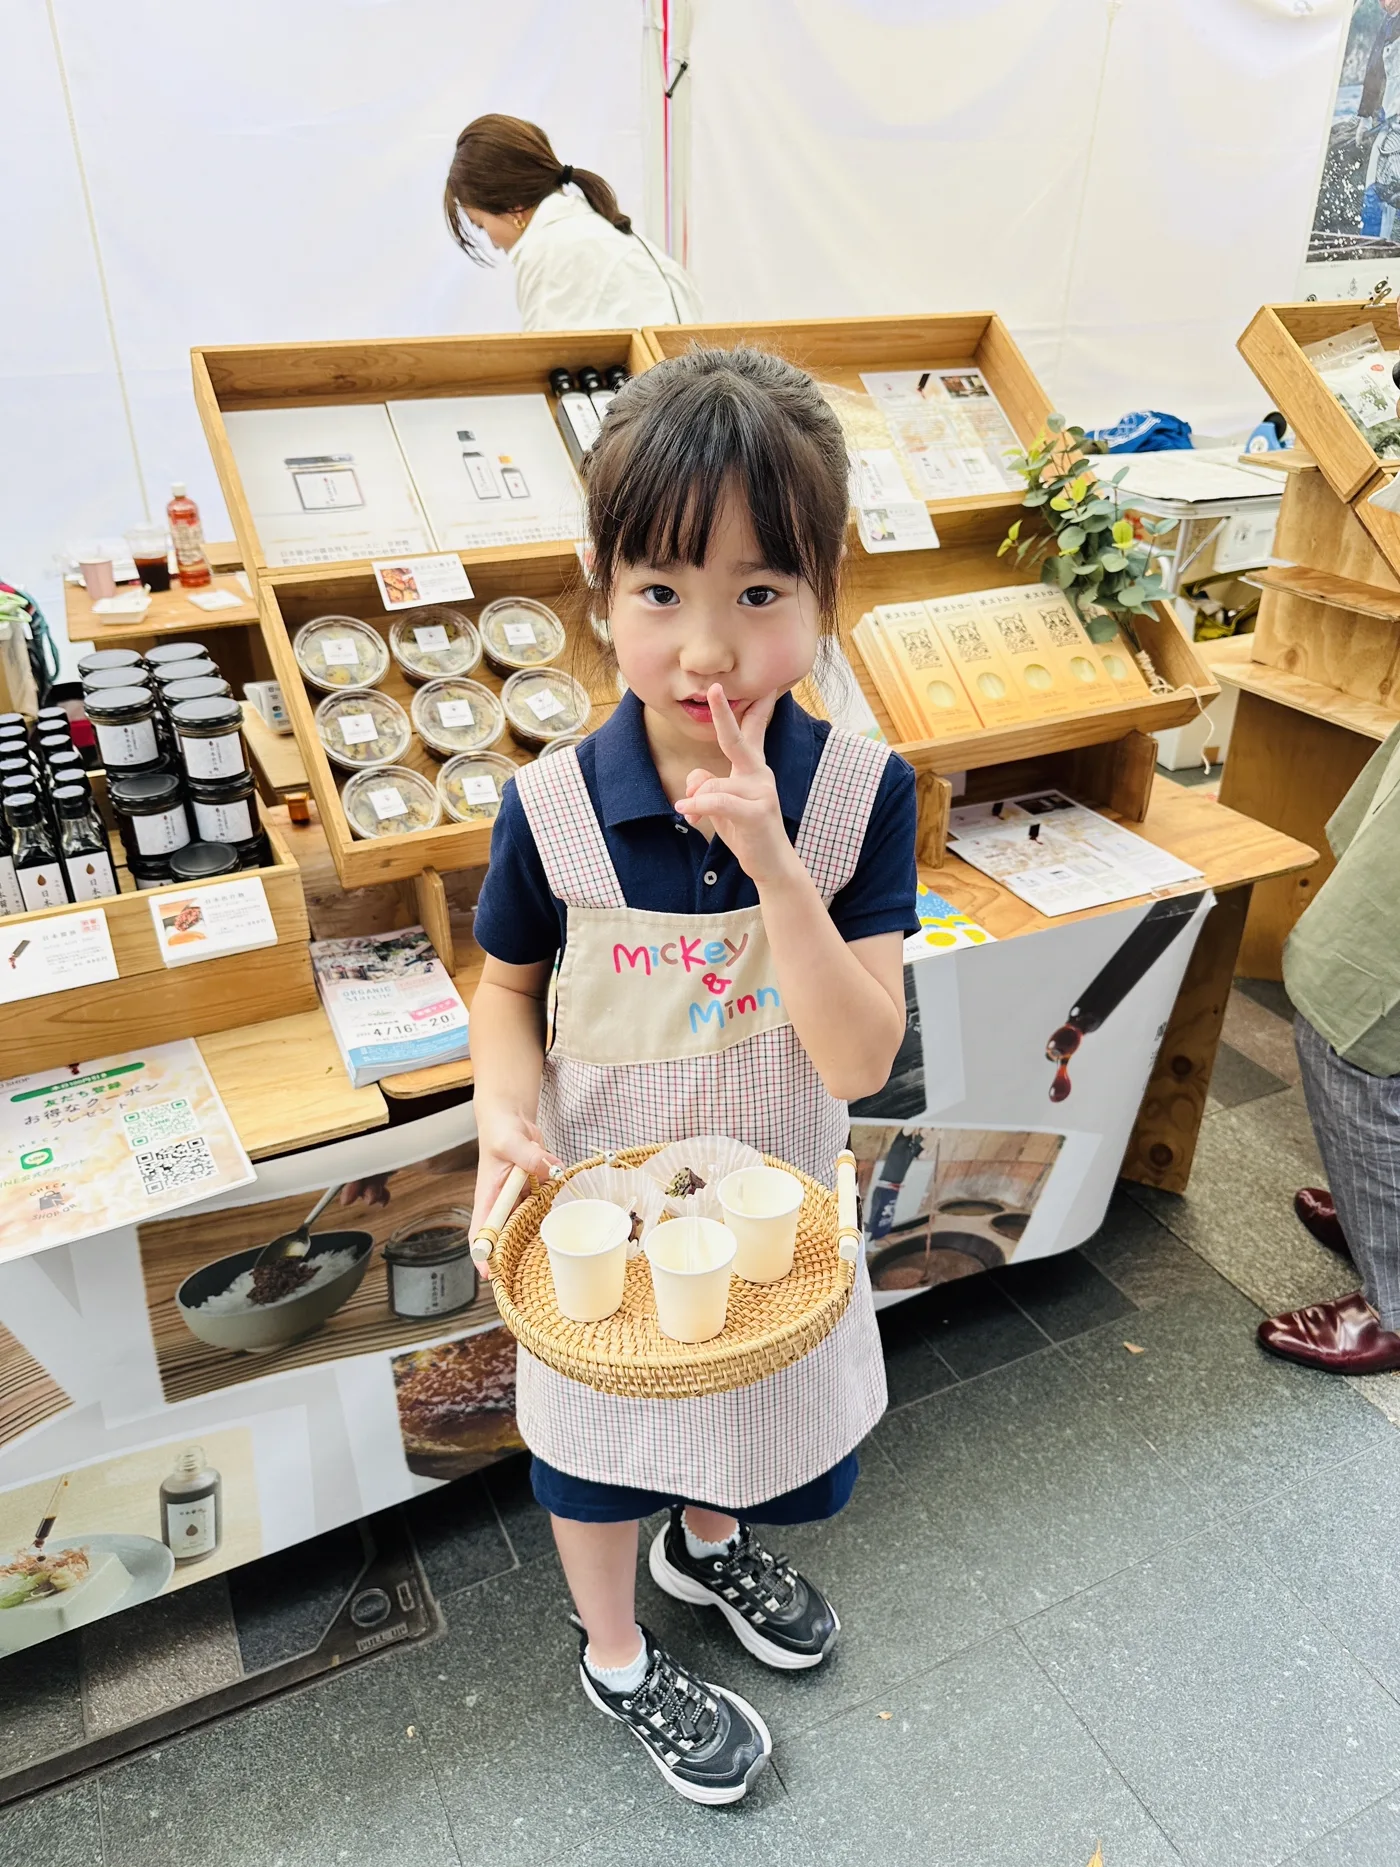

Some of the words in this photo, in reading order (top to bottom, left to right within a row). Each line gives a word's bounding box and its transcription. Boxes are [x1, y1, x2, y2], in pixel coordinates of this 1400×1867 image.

[342, 985, 392, 998] ORGANIC
[702, 972, 732, 995] &
[44, 1081, 122, 1108] 友だち登録
[32, 1210, 60, 1221] SHOP
[62, 1202, 78, 1213] QR
